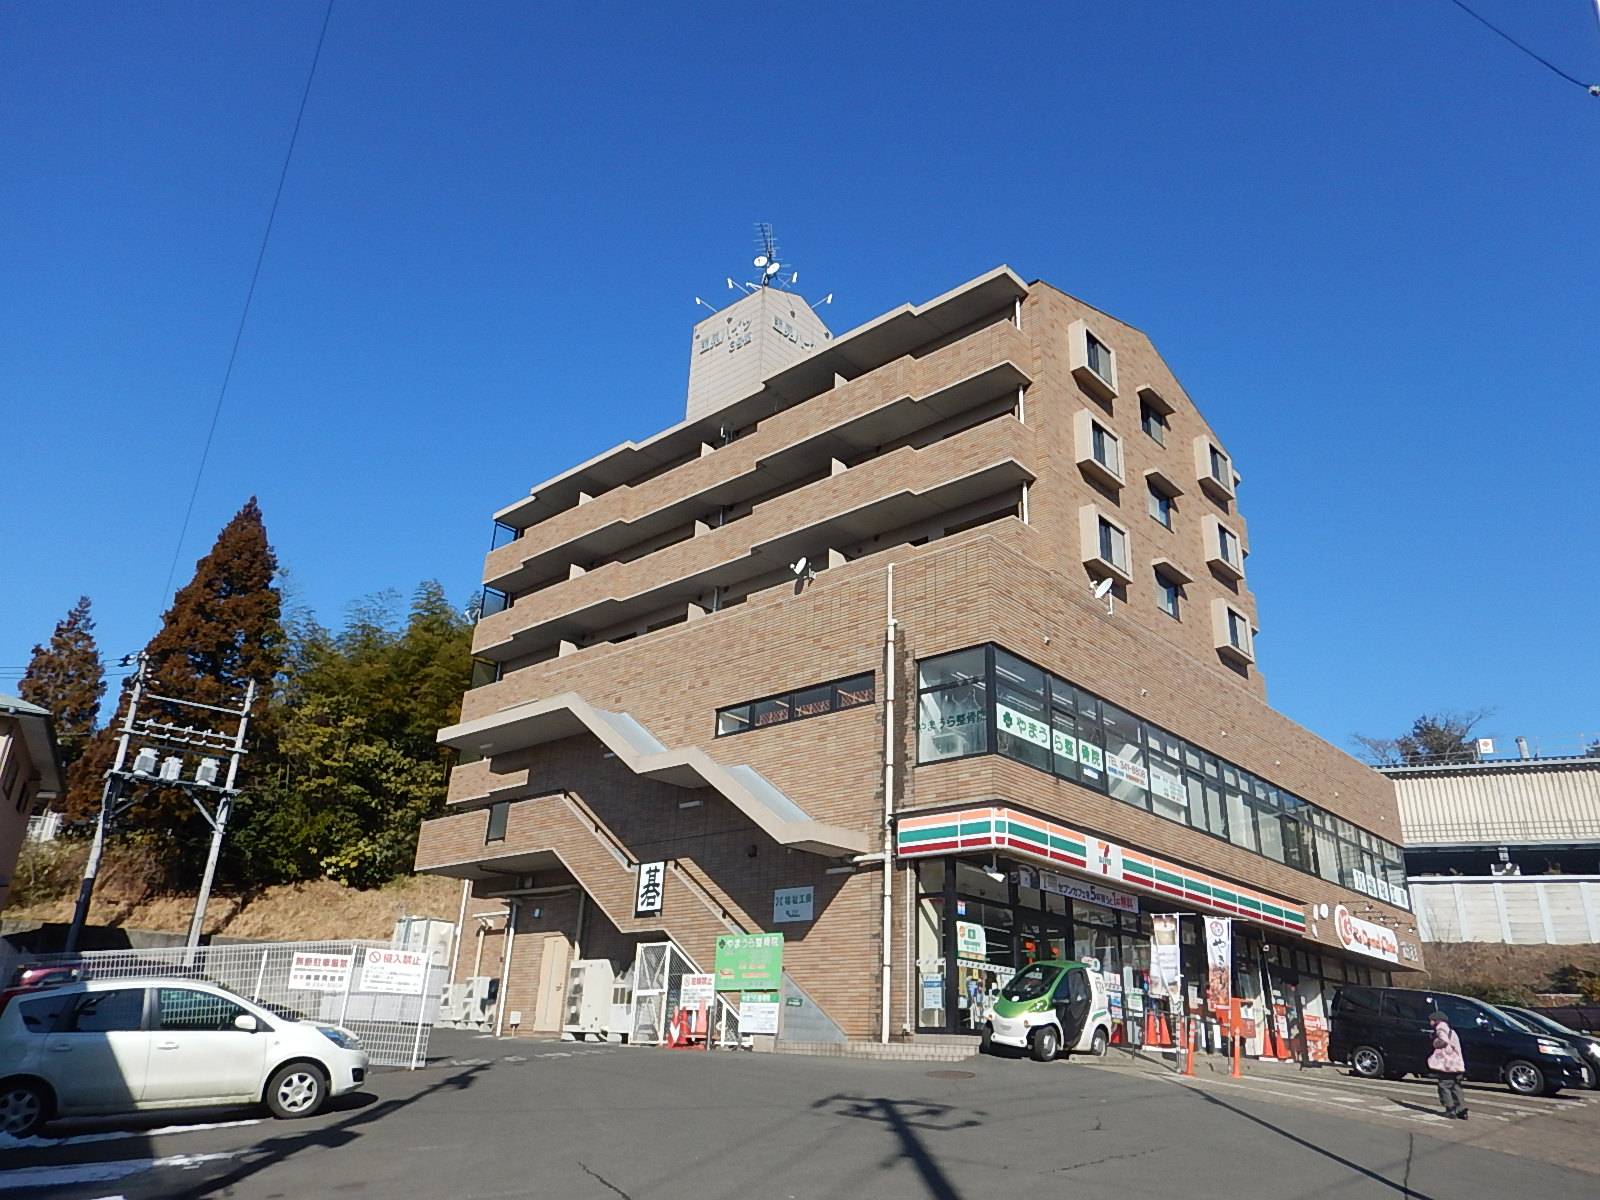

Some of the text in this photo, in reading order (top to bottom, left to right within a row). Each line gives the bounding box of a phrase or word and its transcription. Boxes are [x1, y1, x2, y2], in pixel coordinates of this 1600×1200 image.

[1016, 717, 1100, 767] やまうら整骨院
[640, 865, 661, 908] 碁
[383, 953, 422, 966] 侵入禁止
